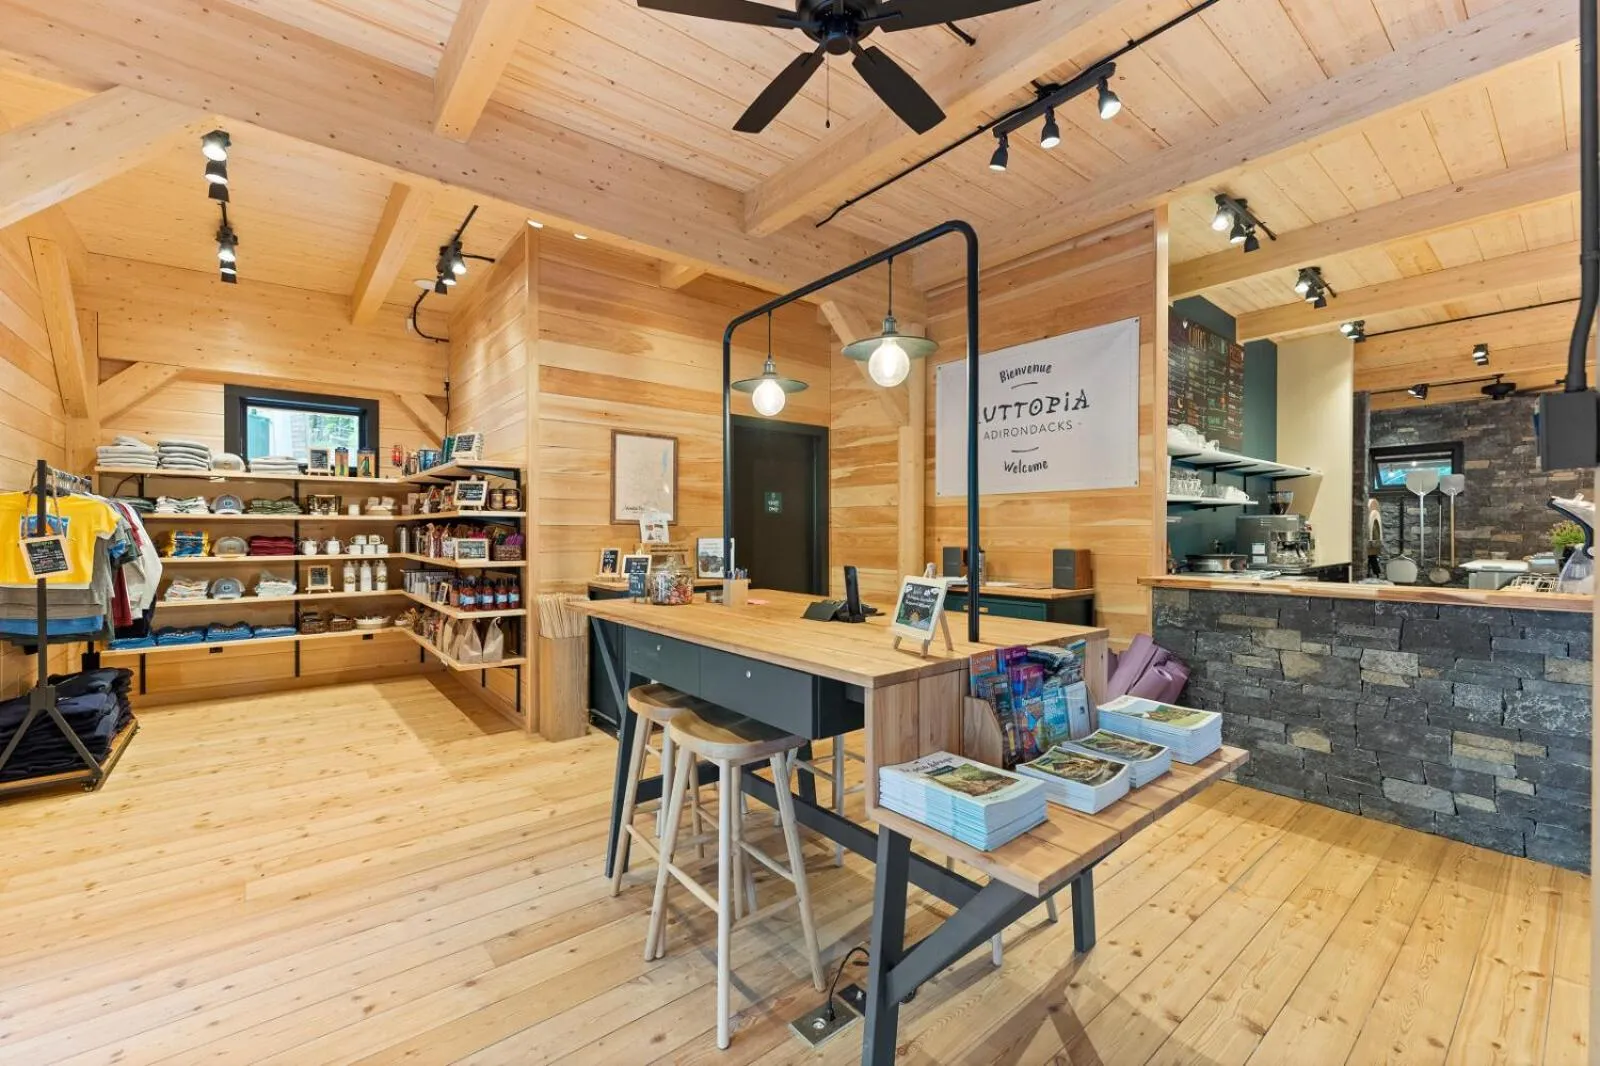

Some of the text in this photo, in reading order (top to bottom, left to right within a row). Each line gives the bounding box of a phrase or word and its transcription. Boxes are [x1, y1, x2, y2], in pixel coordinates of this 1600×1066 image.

[999, 363, 1053, 384] Bienvenue
[983, 420, 1074, 441] ADIRONDACKS
[1003, 459, 1049, 474] Welcome
